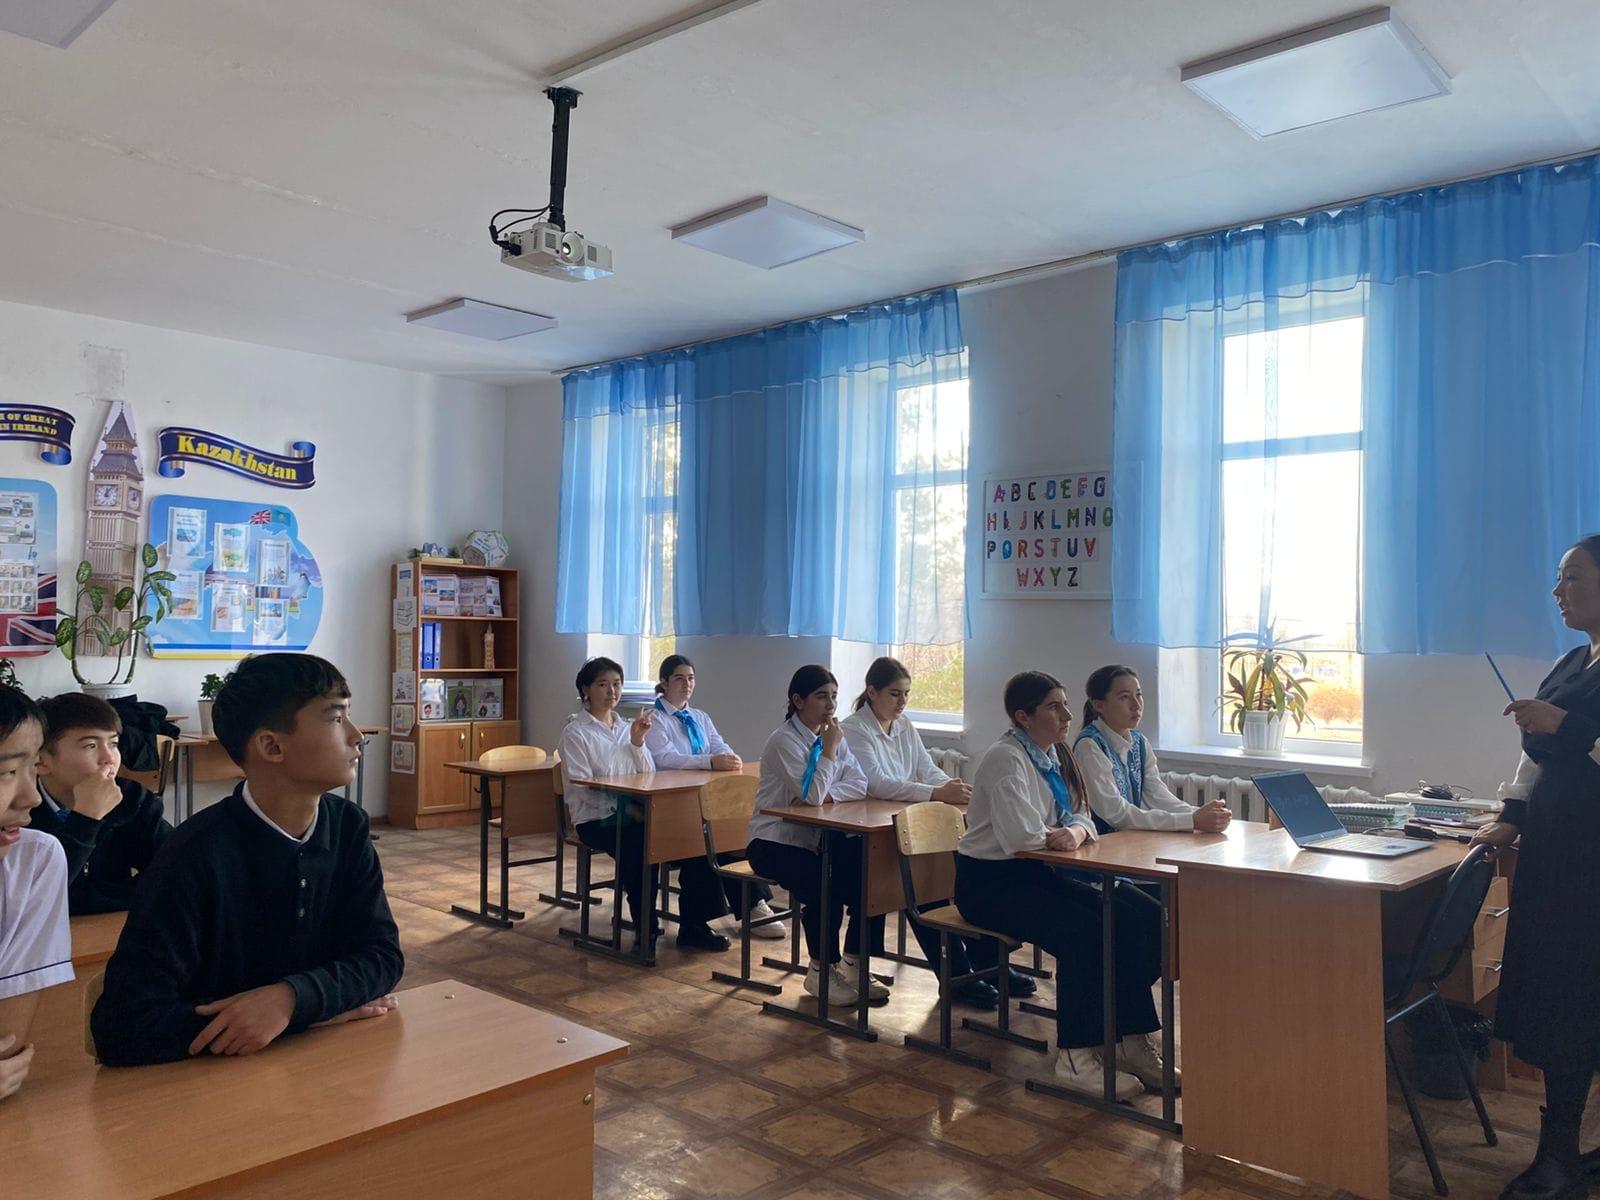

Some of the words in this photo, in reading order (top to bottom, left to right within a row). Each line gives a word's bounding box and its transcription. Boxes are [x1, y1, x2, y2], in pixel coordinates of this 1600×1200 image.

[23, 413, 58, 426] GREAT
[12, 423, 57, 435] IRELAND
[177, 435, 297, 480] Kazakhstan
